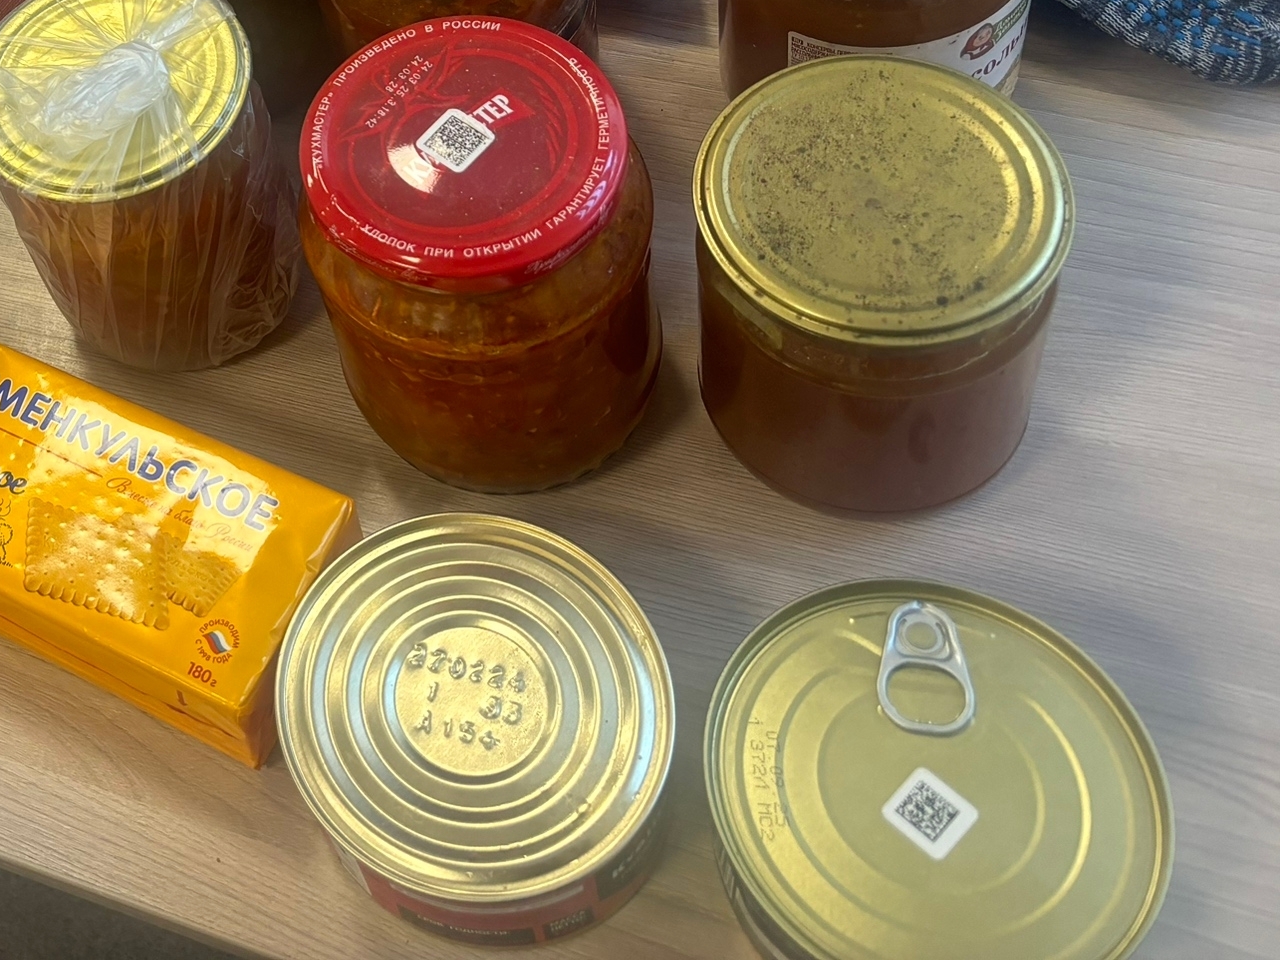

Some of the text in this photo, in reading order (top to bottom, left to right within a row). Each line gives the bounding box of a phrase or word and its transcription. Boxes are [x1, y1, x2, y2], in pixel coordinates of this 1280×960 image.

[333, 29, 417, 88] ПРОИЗВЕДЕНО
[423, 23, 434, 34] В
[441, 19, 502, 32] РОССИИ
[360, 223, 416, 254] ХЛОПОК
[423, 245, 455, 258] ПРИ
[462, 228, 542, 258] ОТКРЫТИИ
[545, 155, 607, 229] ГАРАНТИРУЕТ
[197, 647, 234, 665] 1998 ГОДА
[198, 618, 241, 650] ПРОИЗВОДИМ
